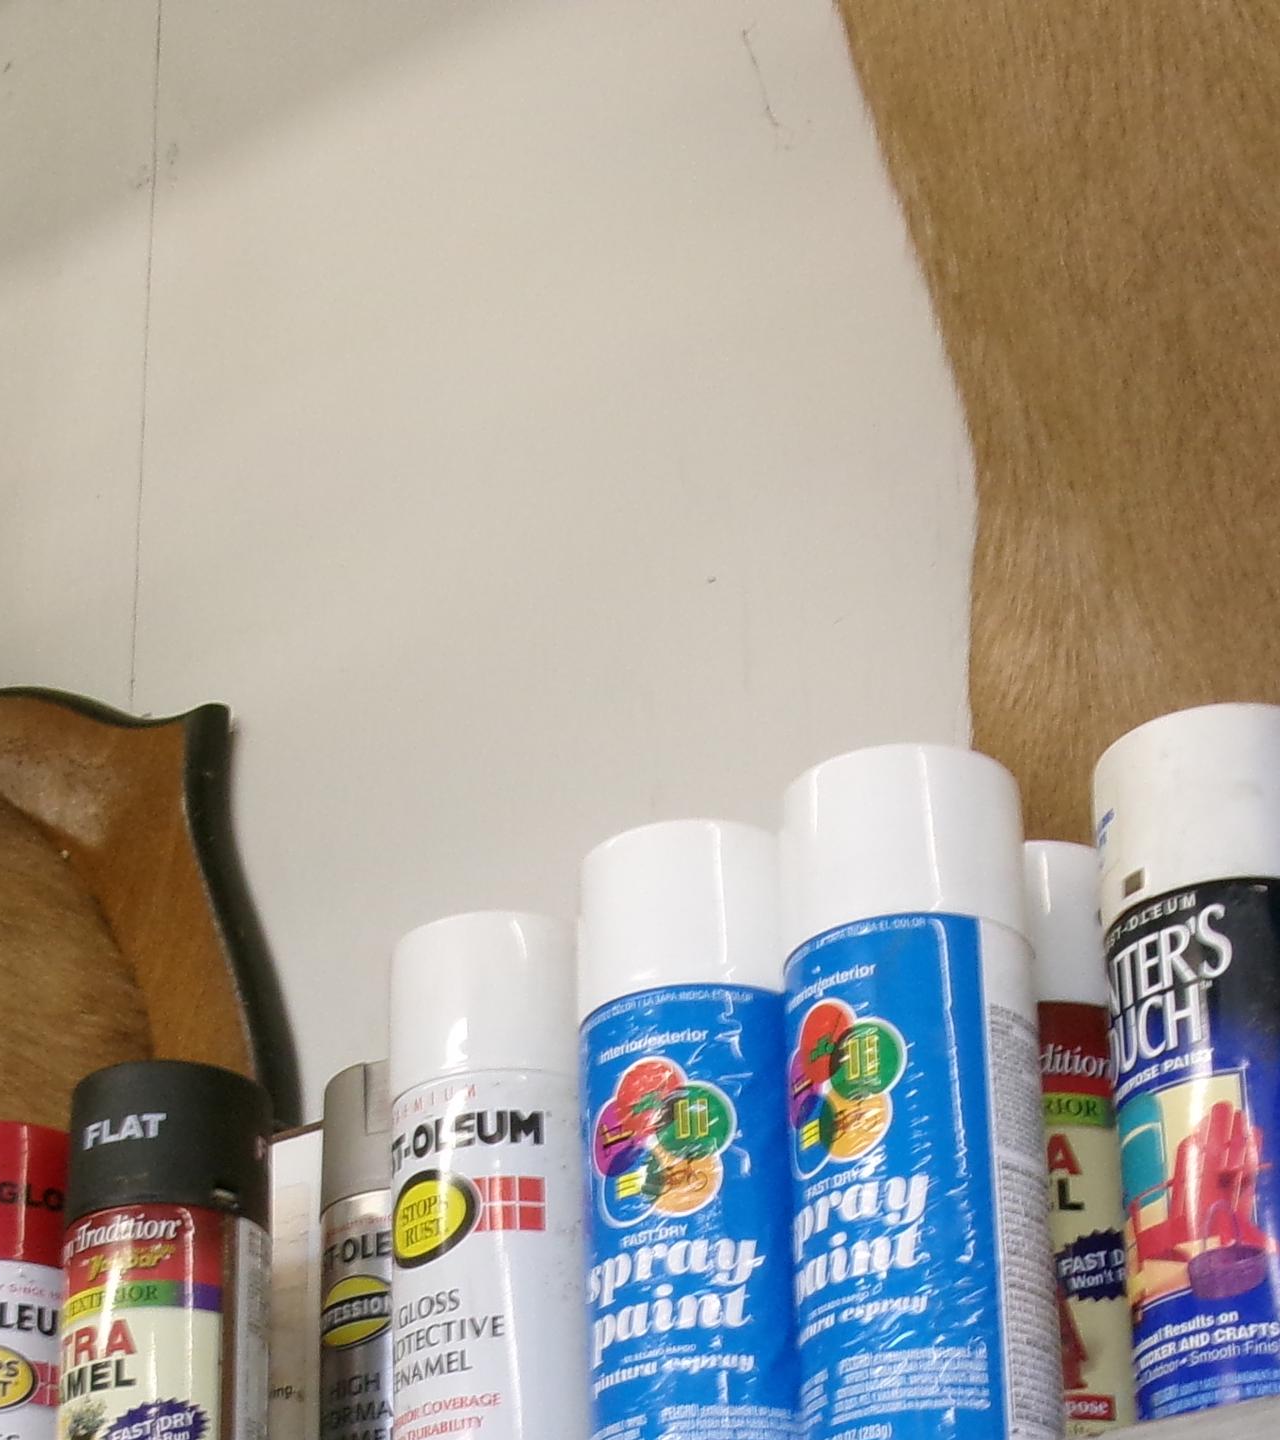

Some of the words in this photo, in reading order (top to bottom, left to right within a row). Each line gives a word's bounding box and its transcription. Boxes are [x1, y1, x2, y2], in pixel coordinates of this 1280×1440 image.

[597, 1027, 710, 1066] interior/exterior
[83, 1112, 167, 1150] FLAT
[806, 1177, 830, 1200] FAST
[794, 1172, 931, 1259] pray
[74, 1212, 181, 1254] Tradition
[405, 1216, 445, 1248] RUST
[622, 1228, 652, 1247] FAST
[656, 1222, 688, 1243] DRY
[587, 1236, 765, 1304] spray
[1059, 1250, 1104, 1277] FAST
[1069, 1265, 1115, 1291] Won't
[398, 1288, 462, 1329] GLOSS
[839, 1294, 930, 1326] espray
[1164, 1313, 1215, 1336] Results
[1218, 1310, 1239, 1325] on
[593, 1282, 753, 1369] paint
[1180, 1333, 1210, 1352] AND
[1213, 1322, 1280, 1343] CRAFTS
[64, 1317, 138, 1367] TRA
[1185, 1343, 1241, 1367] Smooth
[61, 1358, 137, 1401] MEL
[660, 1353, 756, 1375] espray
[157, 1407, 197, 1432] DRY
[422, 1392, 502, 1417] COVERAGE
